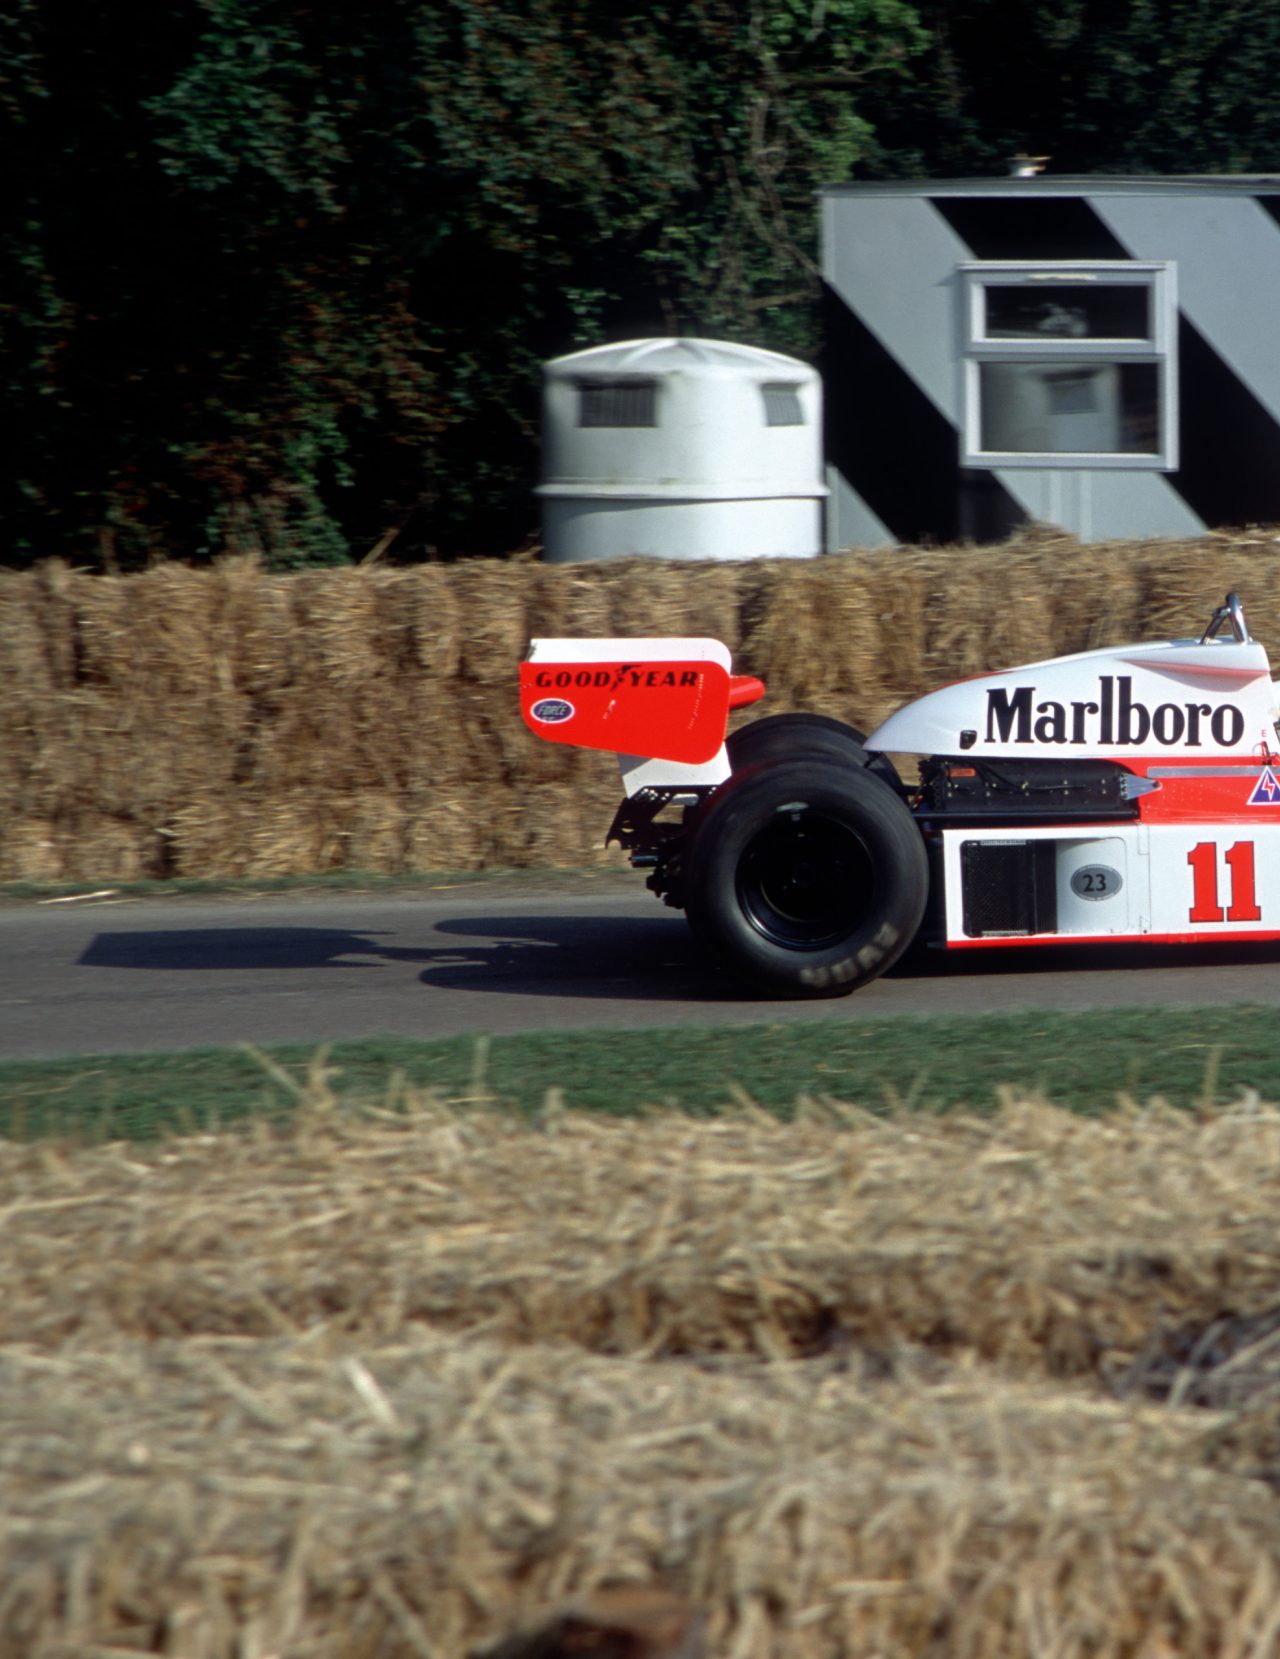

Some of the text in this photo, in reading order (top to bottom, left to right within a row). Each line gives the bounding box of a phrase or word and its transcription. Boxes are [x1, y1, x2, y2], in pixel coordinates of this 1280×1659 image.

[984, 675, 1245, 748] Marlboro
[1082, 874, 1107, 892] 23
[1187, 841, 1262, 923] 11
